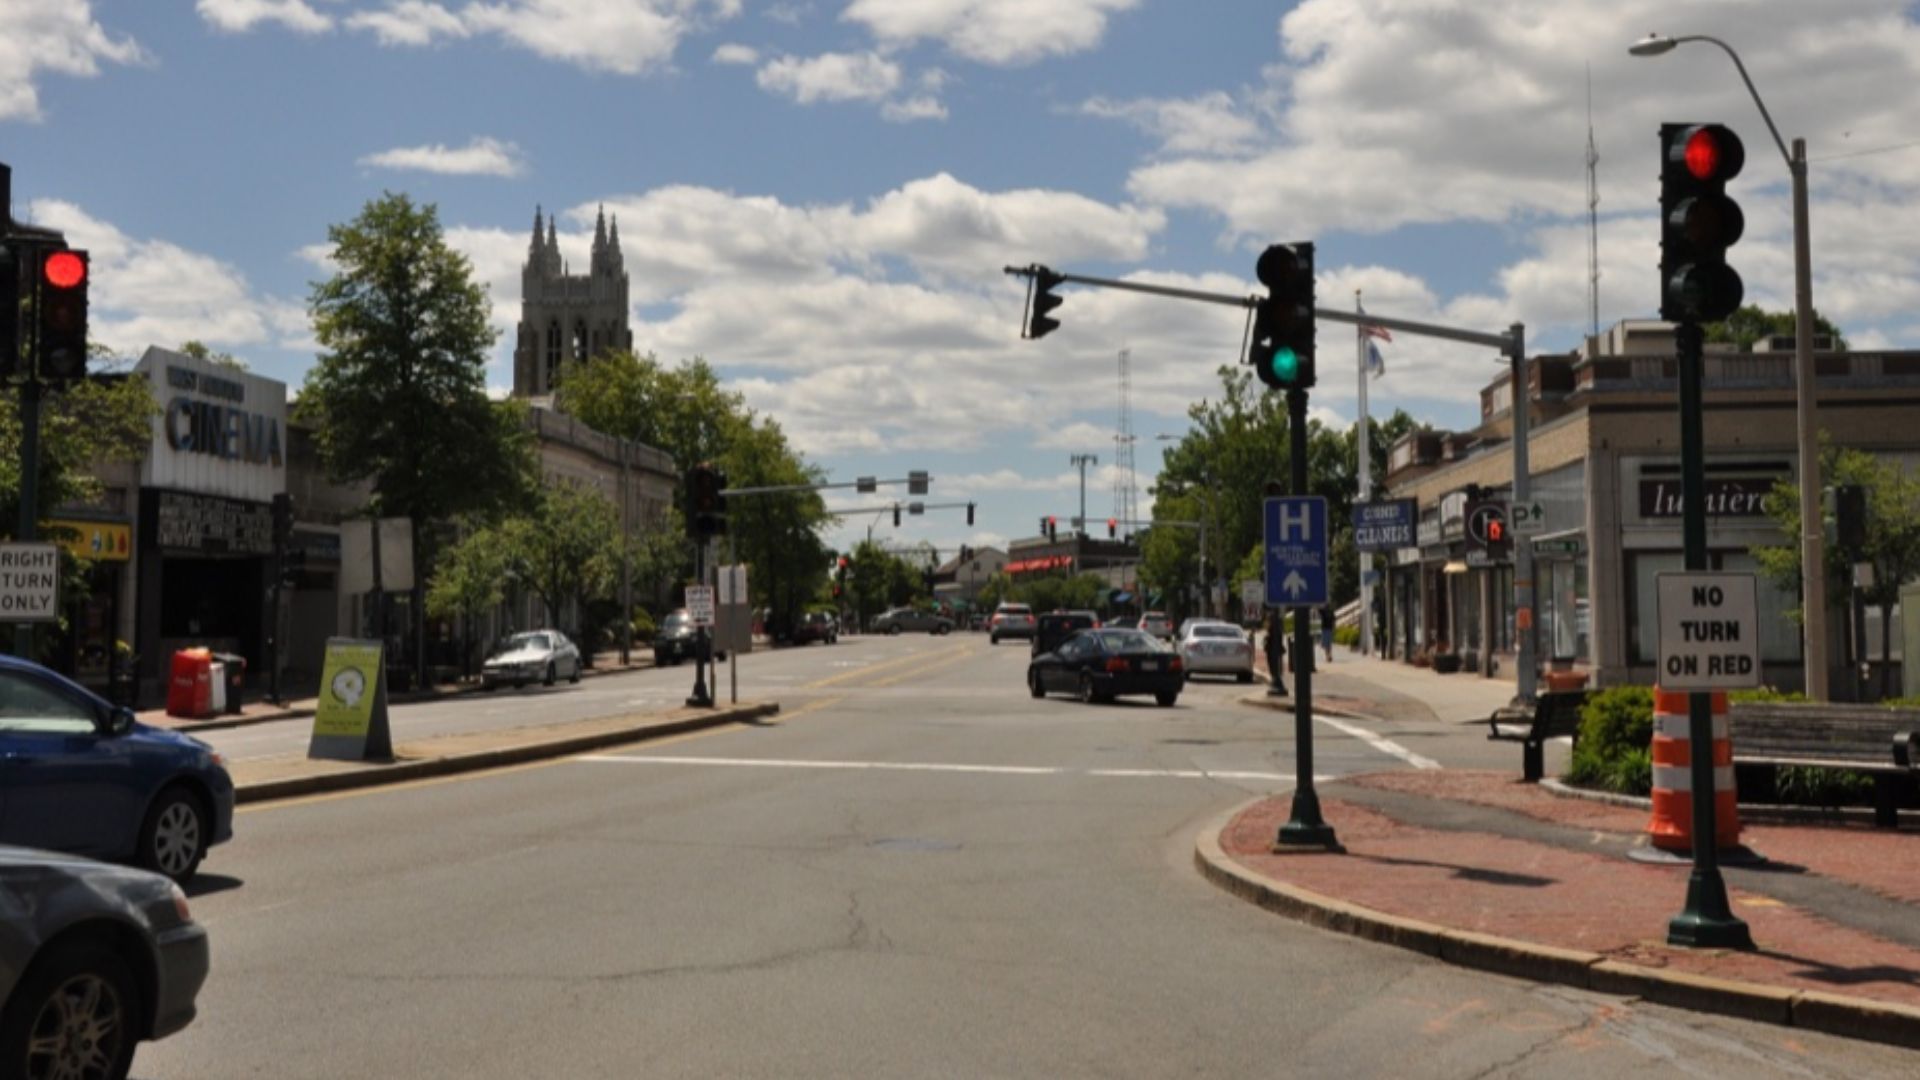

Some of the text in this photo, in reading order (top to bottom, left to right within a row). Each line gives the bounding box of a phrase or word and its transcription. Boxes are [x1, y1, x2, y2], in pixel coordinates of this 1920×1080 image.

[166, 396, 282, 468] CINEMA
[1280, 503, 1310, 541] H
[1512, 506, 1528, 530] P
[1356, 525, 1411, 545] CLEANERS
[1, 551, 54, 567] RIGHT
[2, 573, 52, 588] TURN
[2, 595, 50, 611] ONLY
[1693, 586, 1723, 608] NO
[1681, 621, 1739, 642] TURN
[1667, 655, 1752, 676] ON RED
